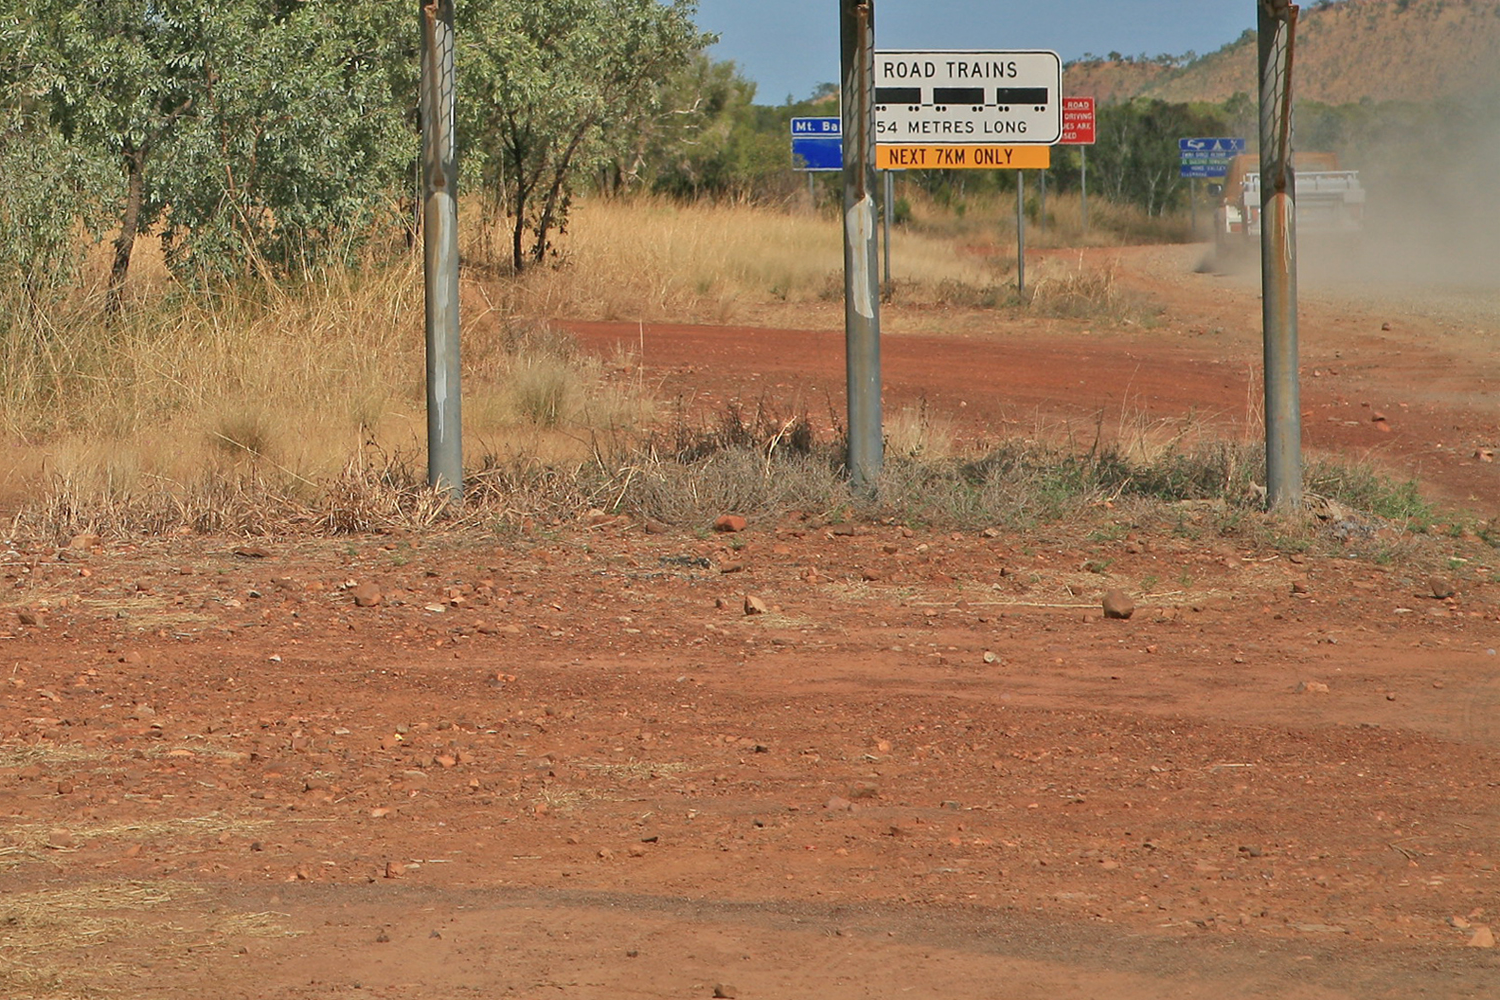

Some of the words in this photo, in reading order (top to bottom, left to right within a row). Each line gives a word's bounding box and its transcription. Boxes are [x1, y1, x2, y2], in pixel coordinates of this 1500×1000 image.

[884, 61, 936, 79] ROAD
[945, 61, 1018, 79] TRAINS
[796, 121, 816, 131] Mt.
[876, 120, 898, 134] 54
[908, 120, 975, 134] METRES
[984, 120, 1027, 134] LONG
[889, 148, 927, 165] NEXT
[935, 148, 965, 165] 7KM
[974, 148, 1013, 165] ONLY
